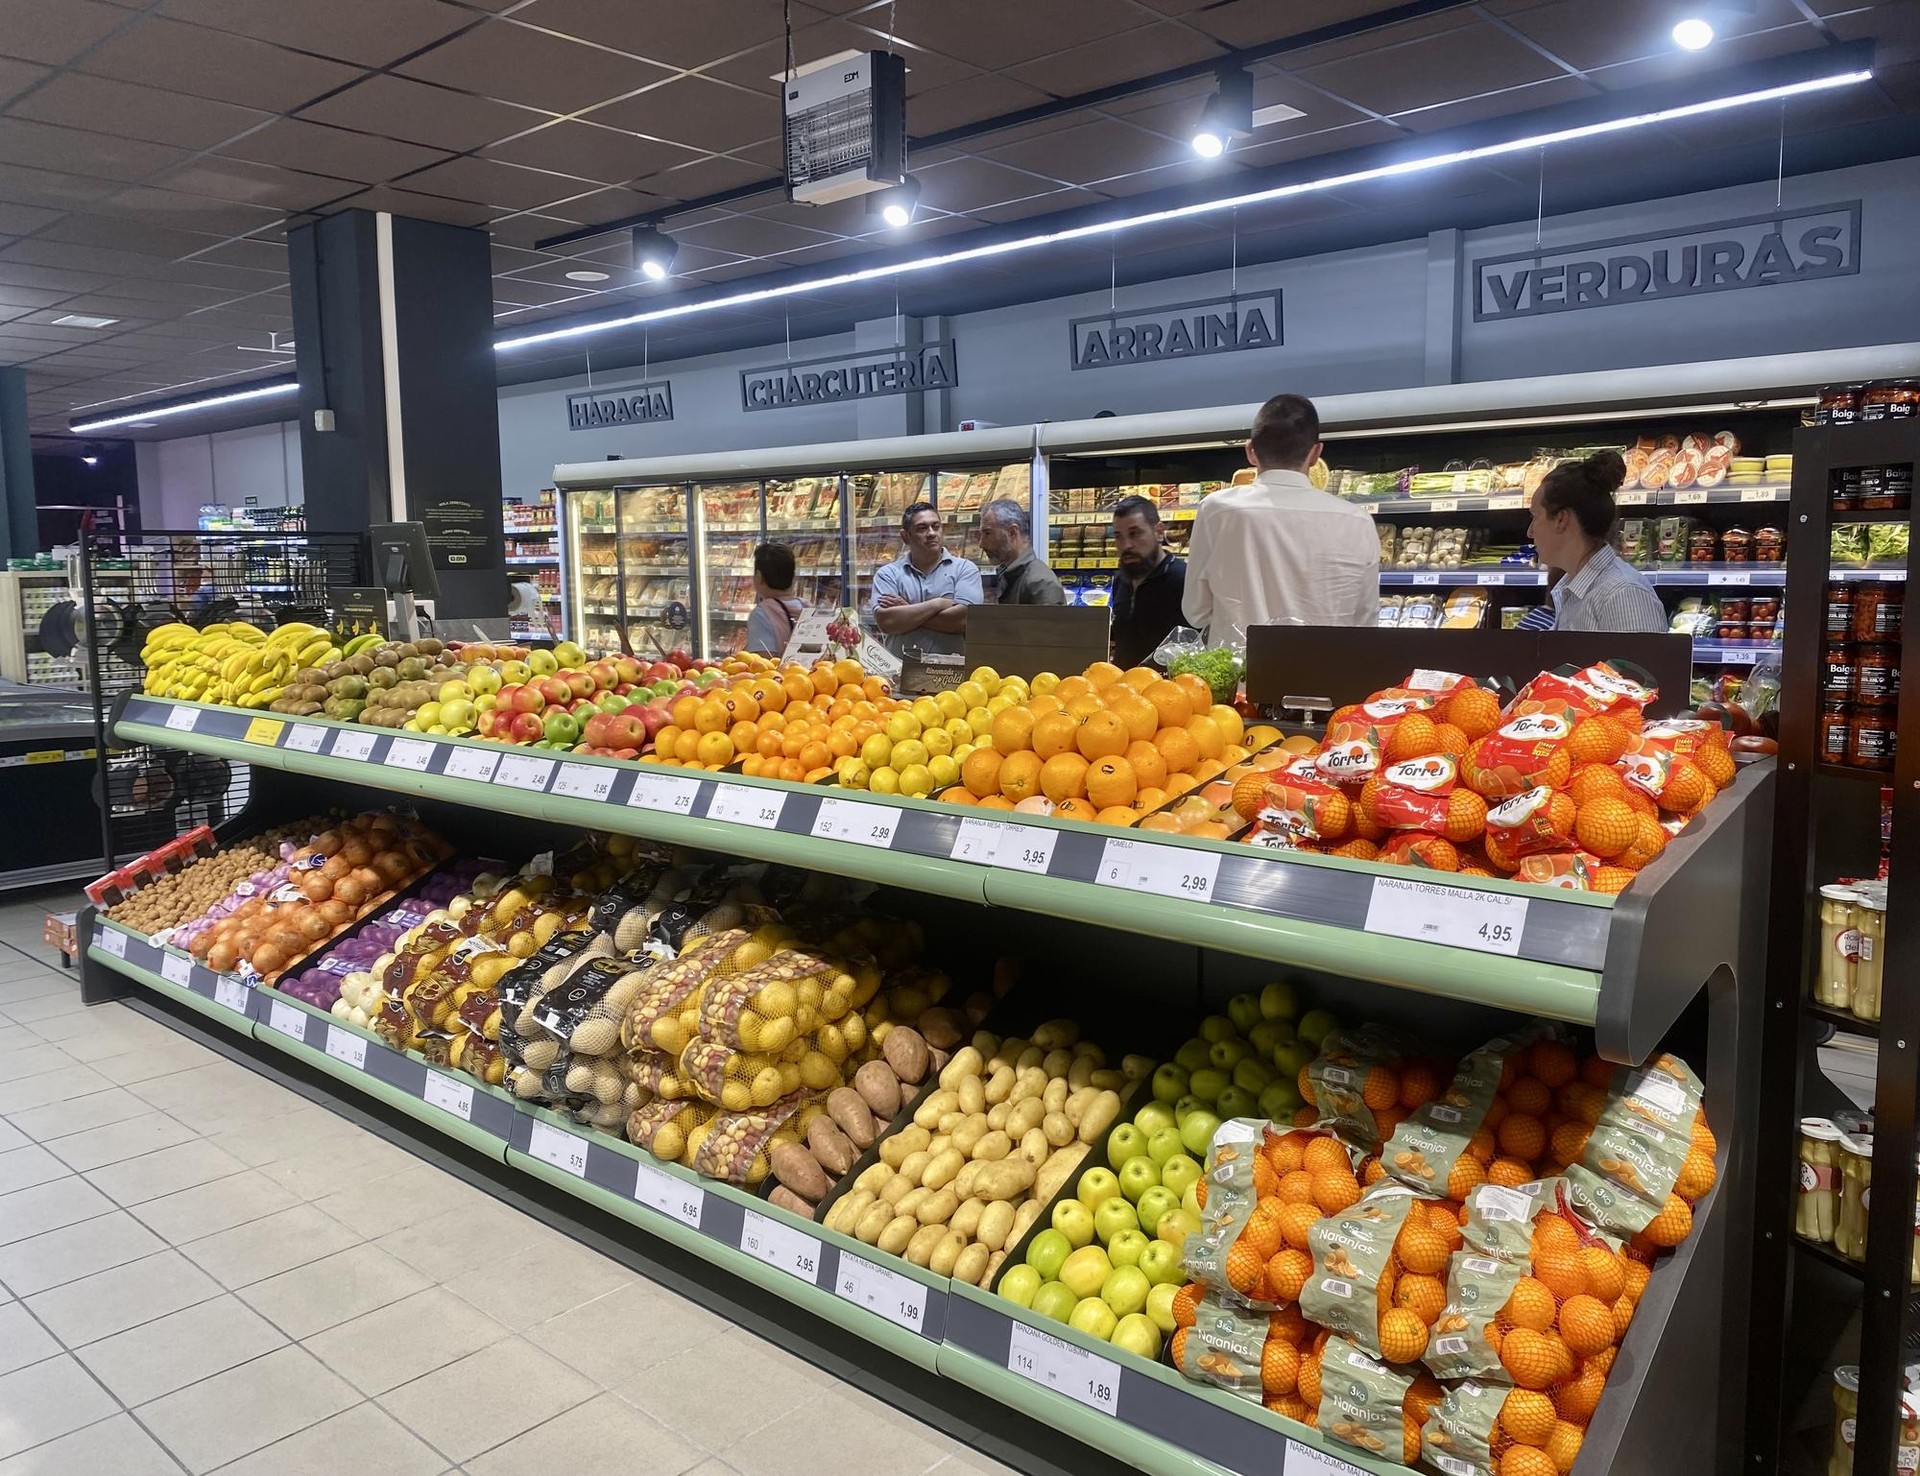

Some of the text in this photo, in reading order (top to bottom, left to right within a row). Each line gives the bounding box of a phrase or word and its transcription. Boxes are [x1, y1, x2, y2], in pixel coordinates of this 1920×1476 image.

[844, 71, 859, 83] EDM
[1486, 226, 1844, 313] VERDURAS
[1082, 308, 1272, 364] ARRAINA
[748, 350, 948, 406] CHARCUTERÍA
[574, 393, 668, 426] HARAGIA
[1513, 717, 1562, 733] Torres
[1328, 750, 1368, 768] Torres
[1398, 762, 1445, 777] Torres
[594, 783, 608, 796] 3,95
[675, 796, 690, 808] 2,75
[1498, 789, 1541, 816] Torres
[759, 808, 776, 822] 3,25
[870, 825, 890, 841] 2,99
[963, 843, 971, 854] 2
[1109, 839, 1133, 849] POMELO
[1023, 849, 1045, 865] 3,95
[1110, 868, 1118, 880] 6
[1181, 874, 1208, 894] 2,99
[1378, 878, 1413, 891] NARANJA
[1415, 884, 1446, 896] TORRES
[1447, 889, 1473, 900] MALLA
[1474, 892, 1486, 902] 2K
[1478, 922, 1512, 944] 4,95
[1402, 1133, 1447, 1154] Naranjas
[570, 1153, 583, 1169] 5,75
[1603, 1139, 1664, 1177] Naranjas
[683, 1202, 697, 1218] 6,95
[1319, 1228, 1374, 1257] Naranjas
[796, 1255, 813, 1273] 2,95
[844, 1281, 854, 1293] 46
[900, 1301, 918, 1320] 1,99
[1015, 1322, 1041, 1338] MANZANA
[1041, 1332, 1065, 1350] GOLDEN
[1197, 1327, 1248, 1356] Naranjas
[1017, 1354, 1032, 1371] 114
[1088, 1380, 1111, 1402] 1,89
[1332, 1394, 1387, 1422] Naranjas
[1289, 1441, 1323, 1463] NARANJA
[1323, 1456, 1347, 1474] ZUMO
